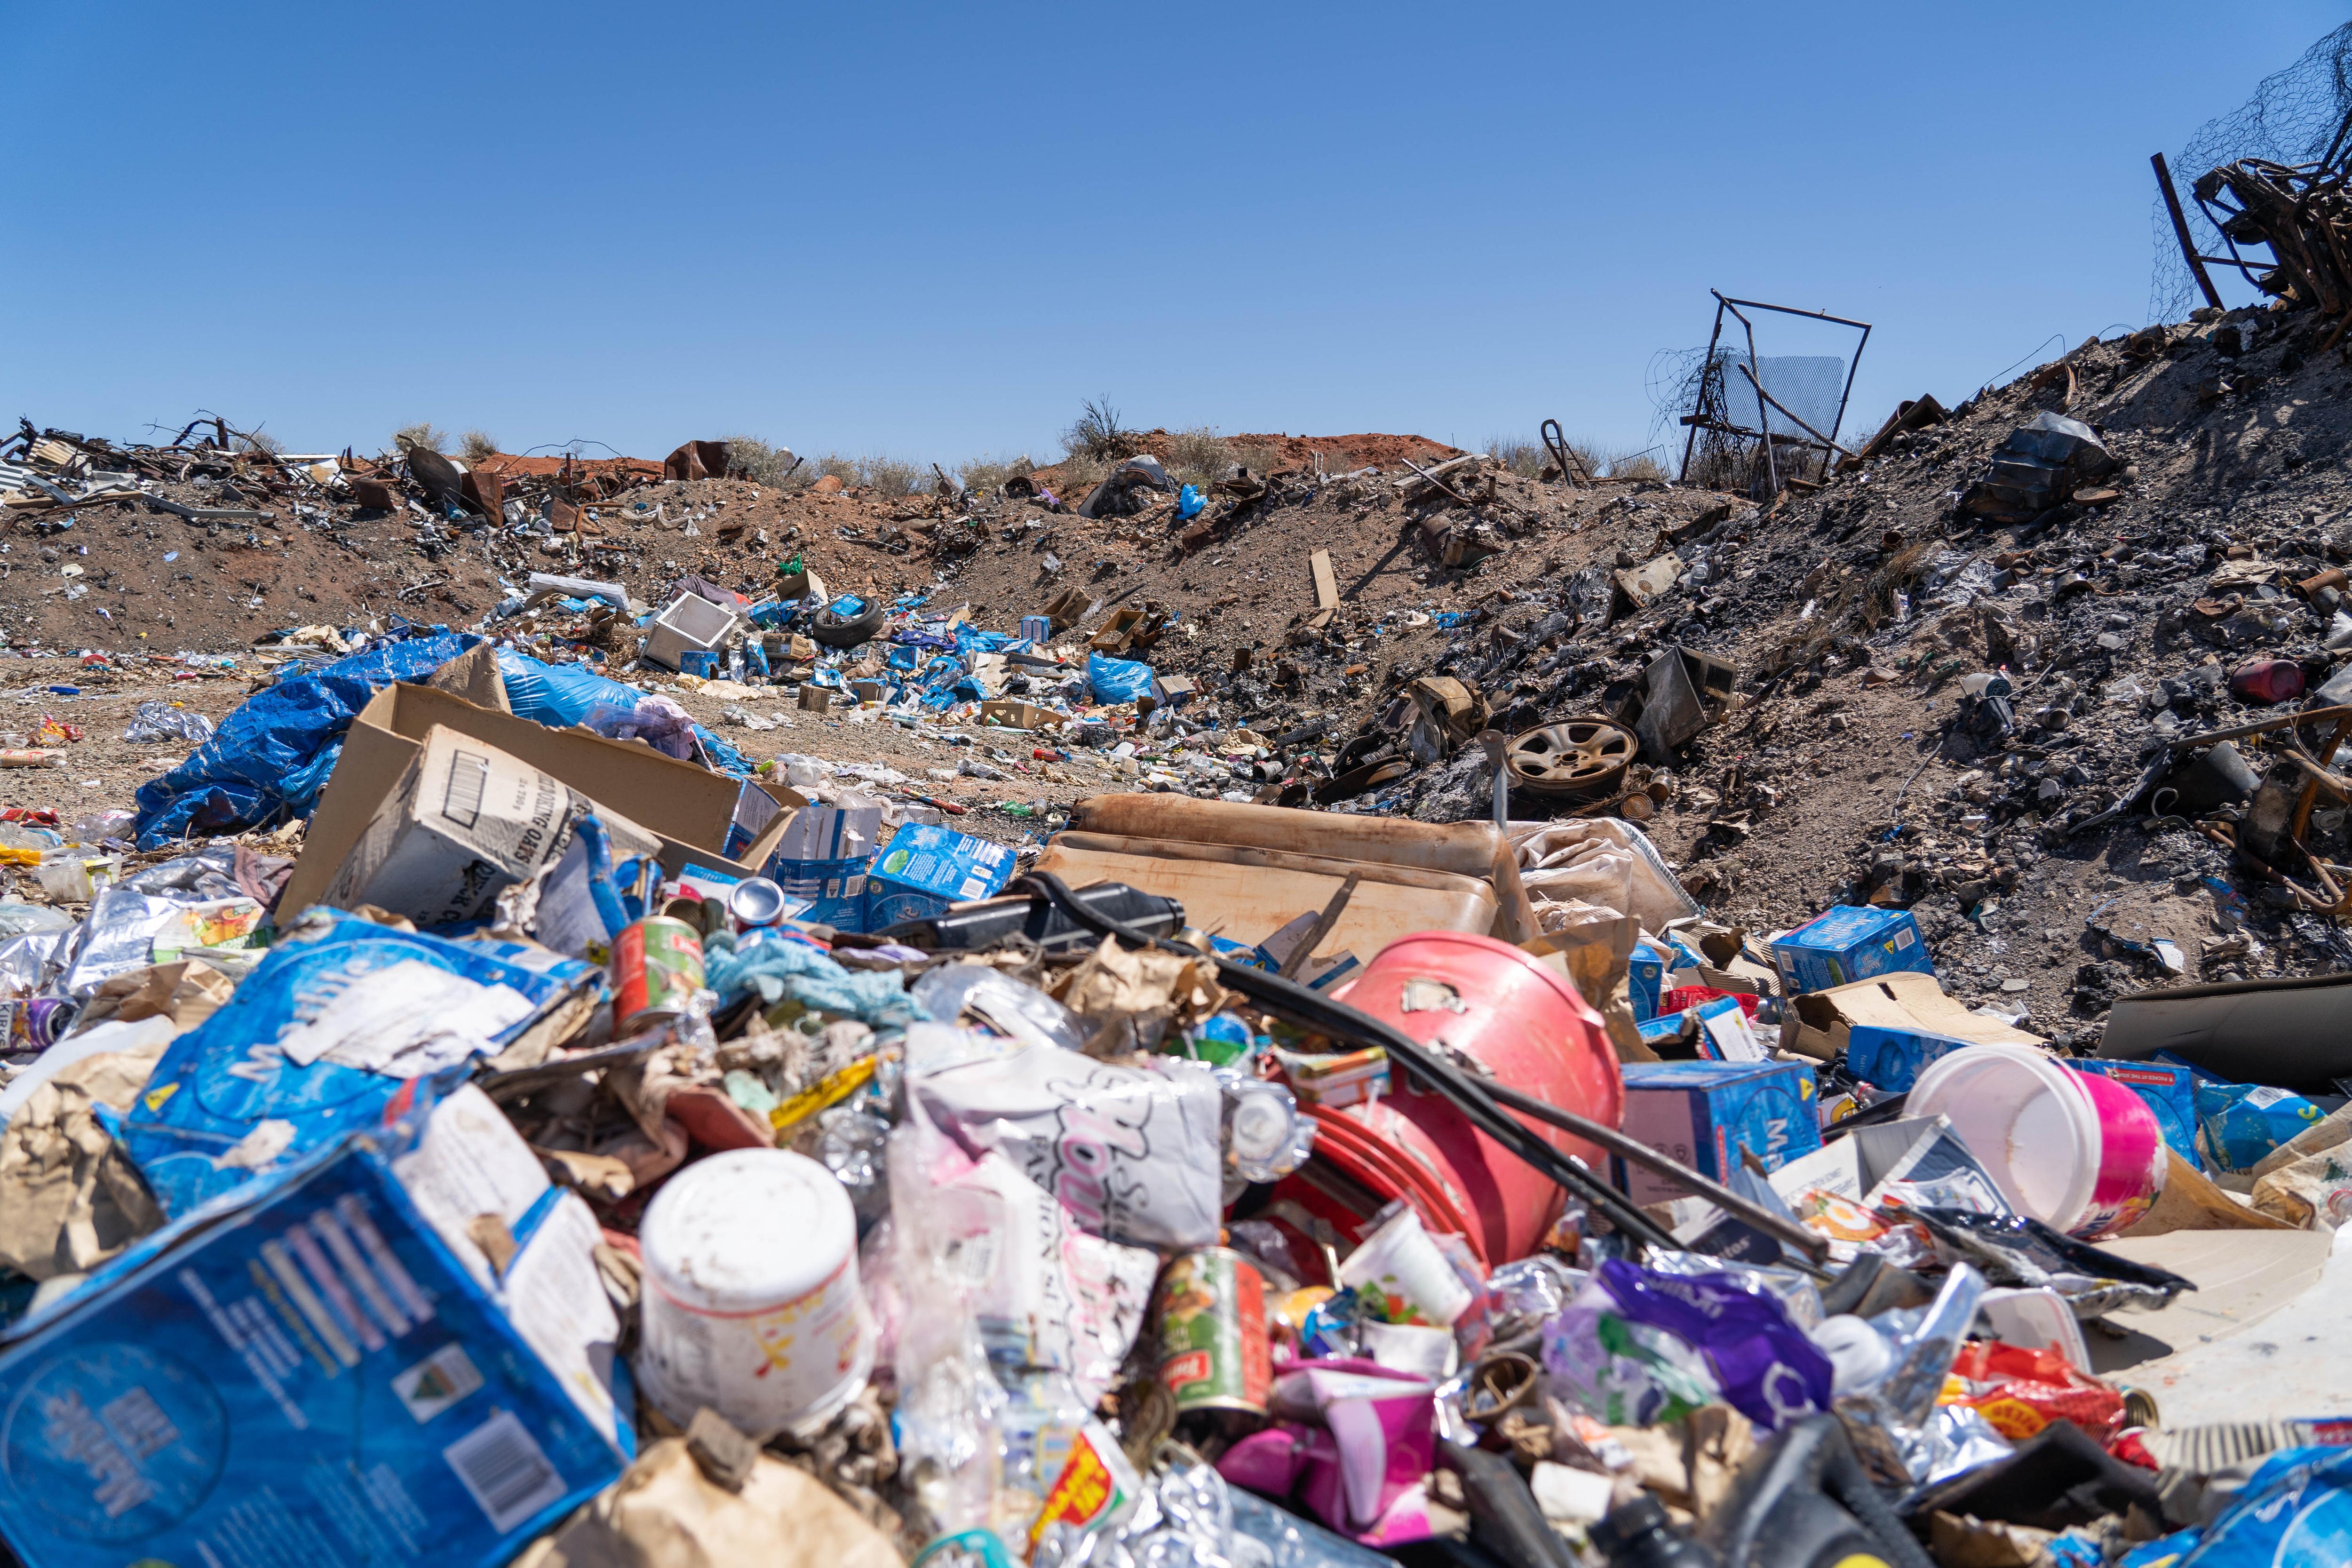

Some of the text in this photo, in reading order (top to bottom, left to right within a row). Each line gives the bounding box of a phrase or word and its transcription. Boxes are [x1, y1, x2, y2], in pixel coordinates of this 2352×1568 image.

[514, 828, 542, 864] OATS
[1821, 918, 1873, 941] Marble
[0, 1003, 11, 1047] KIRKS
